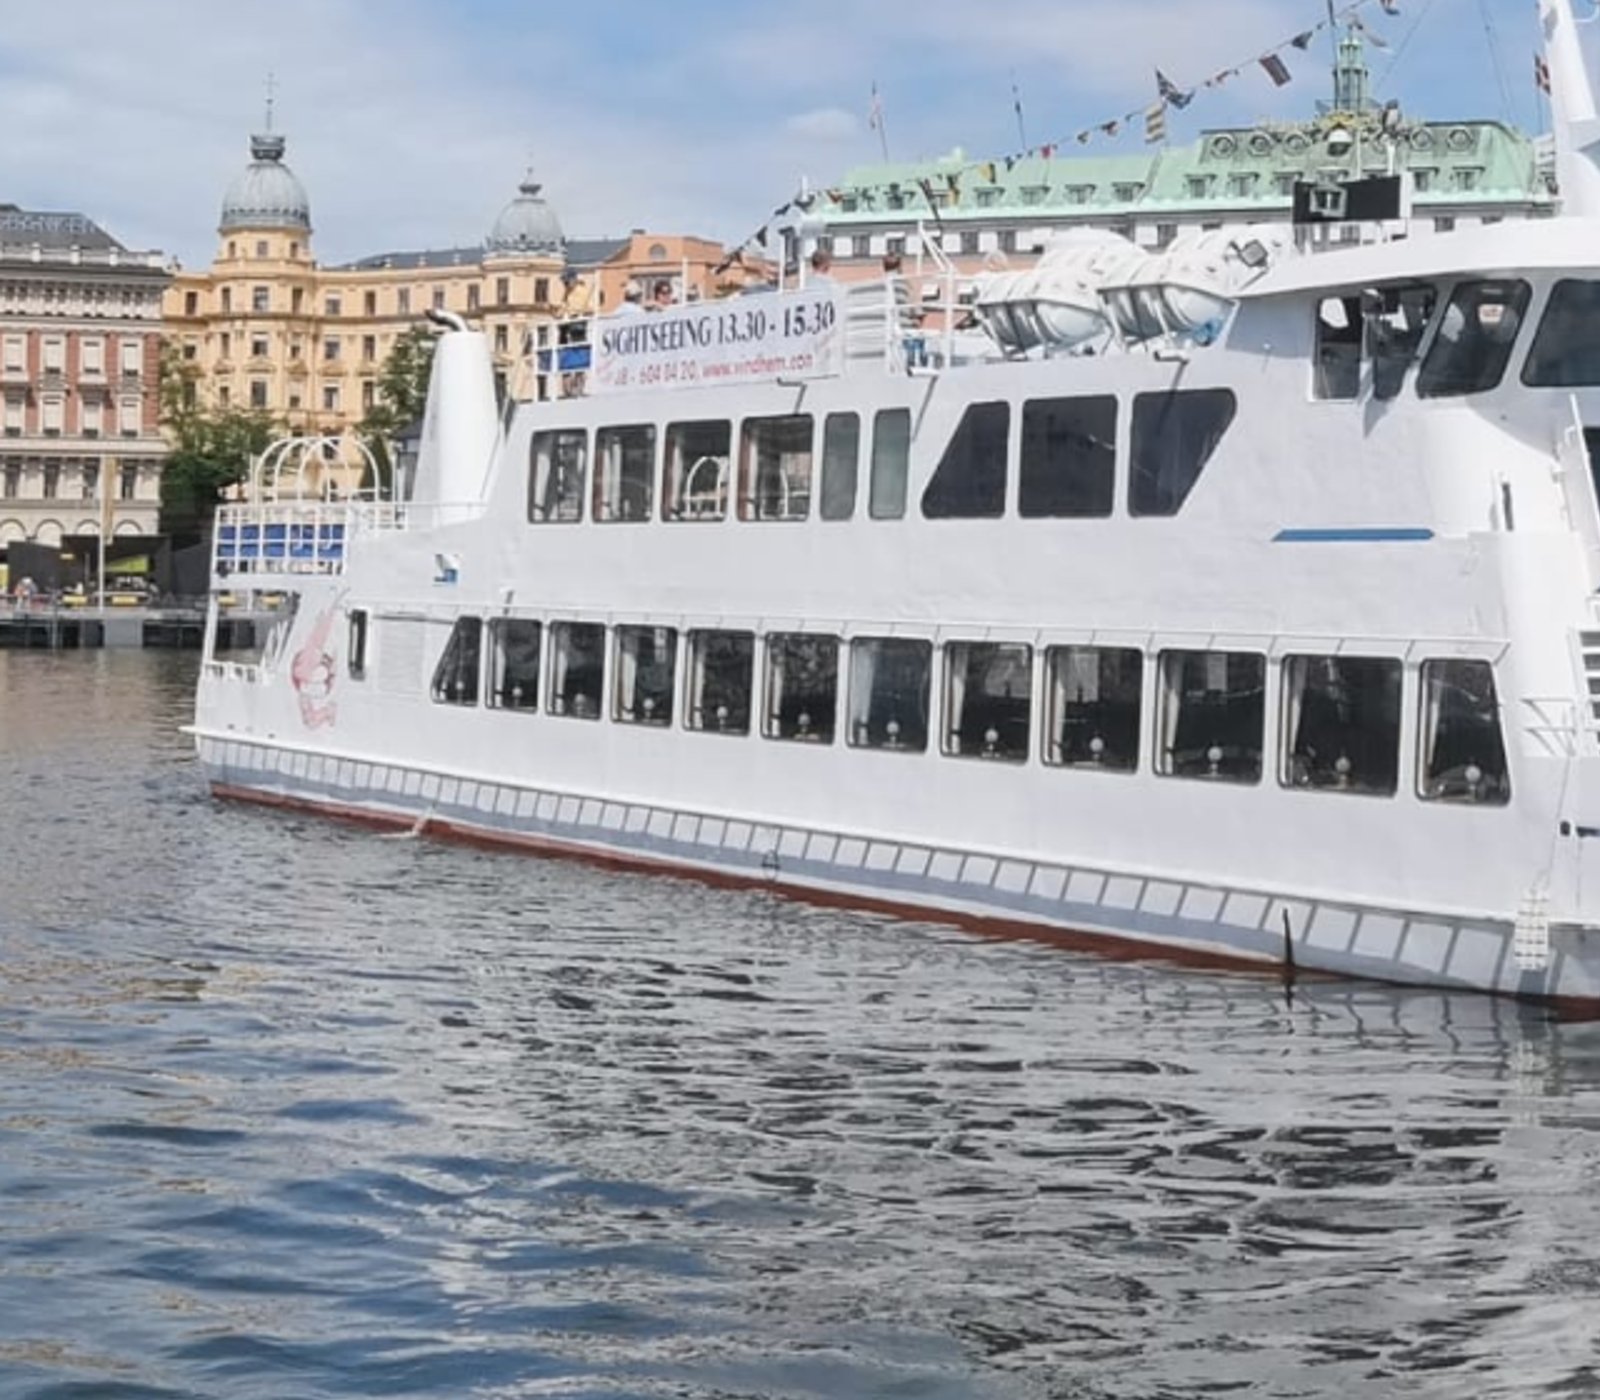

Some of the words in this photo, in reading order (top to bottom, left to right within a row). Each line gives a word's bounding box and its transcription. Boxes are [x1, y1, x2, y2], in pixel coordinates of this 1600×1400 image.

[602, 316, 711, 356] SIGHTSEEING
[717, 310, 766, 345] 13.30
[783, 300, 836, 337] 15.30
